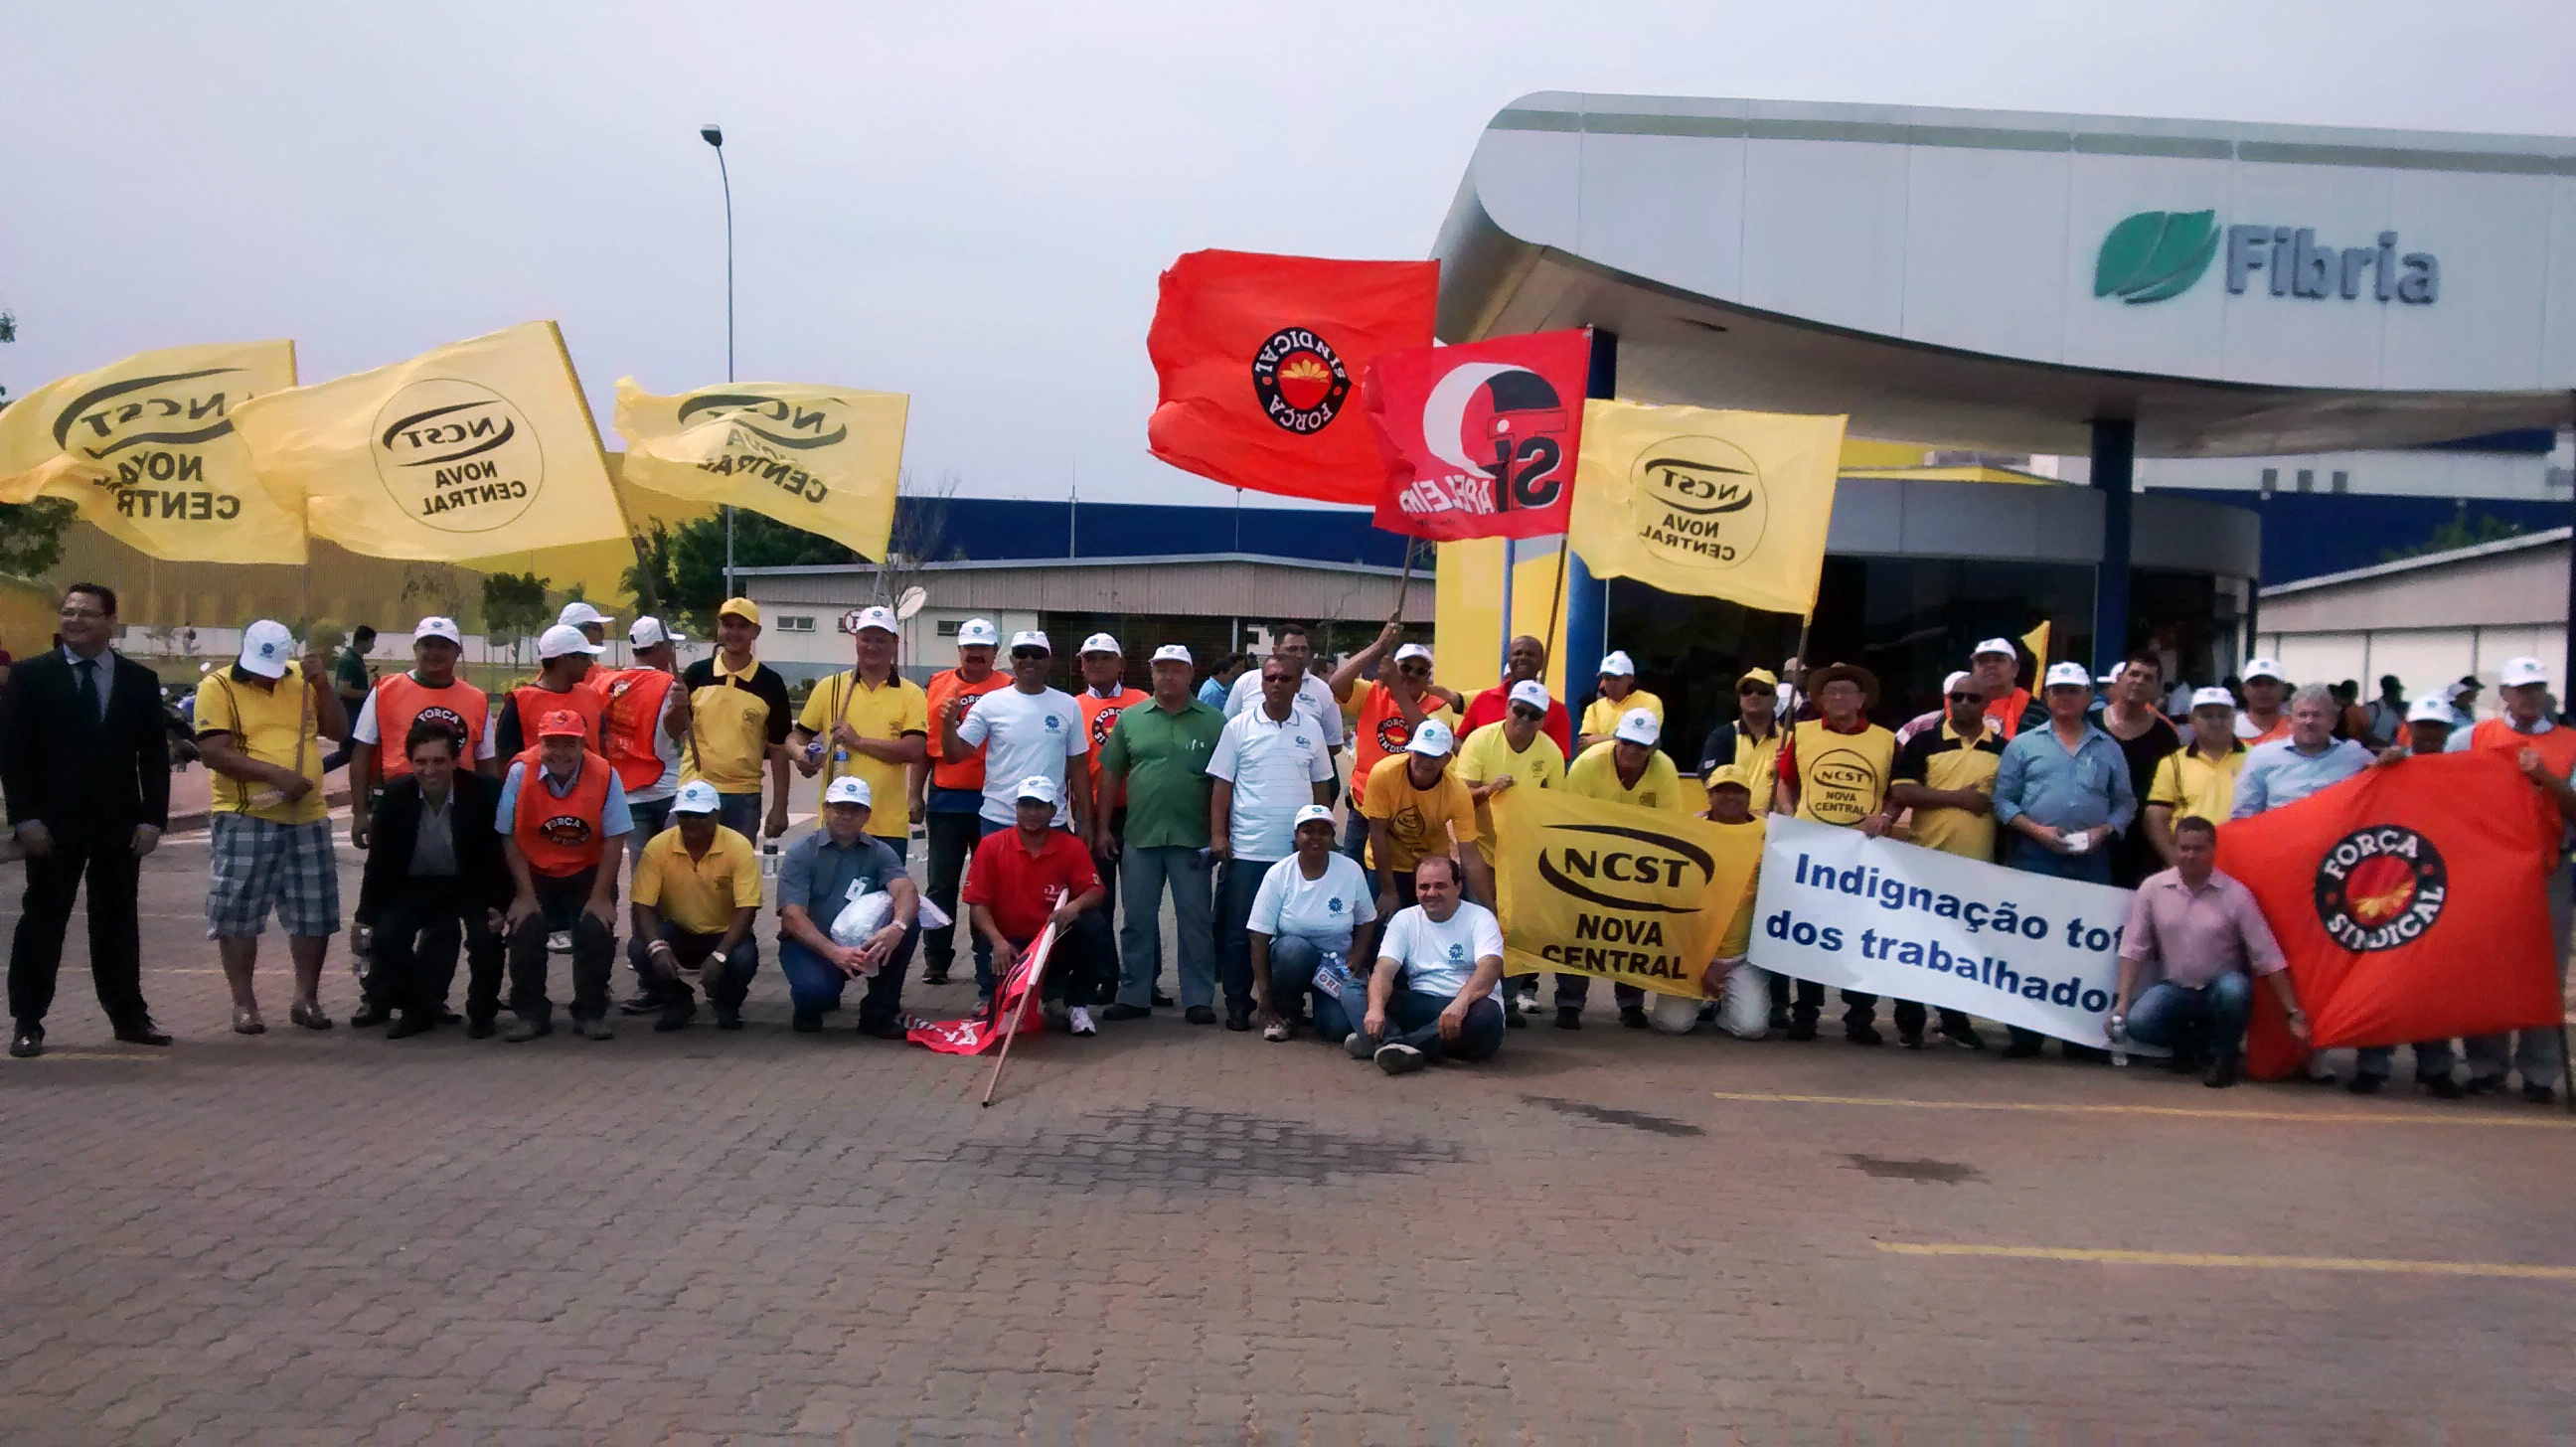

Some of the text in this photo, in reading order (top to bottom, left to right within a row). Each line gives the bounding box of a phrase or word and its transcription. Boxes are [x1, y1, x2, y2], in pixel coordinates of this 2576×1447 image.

[2224, 224, 2440, 305] Fibria
[1255, 331, 1347, 379] SINDICAL
[1822, 770, 1864, 783] NCST
[1815, 802, 1867, 815] CENTRAL
[1826, 791, 1857, 802] NOVA
[1564, 848, 1690, 887] NCST
[1795, 853, 2048, 940] Indignação
[1575, 912, 1665, 947] NOVA
[1765, 909, 1844, 952] dos
[1541, 944, 1689, 980] CENTRAL
